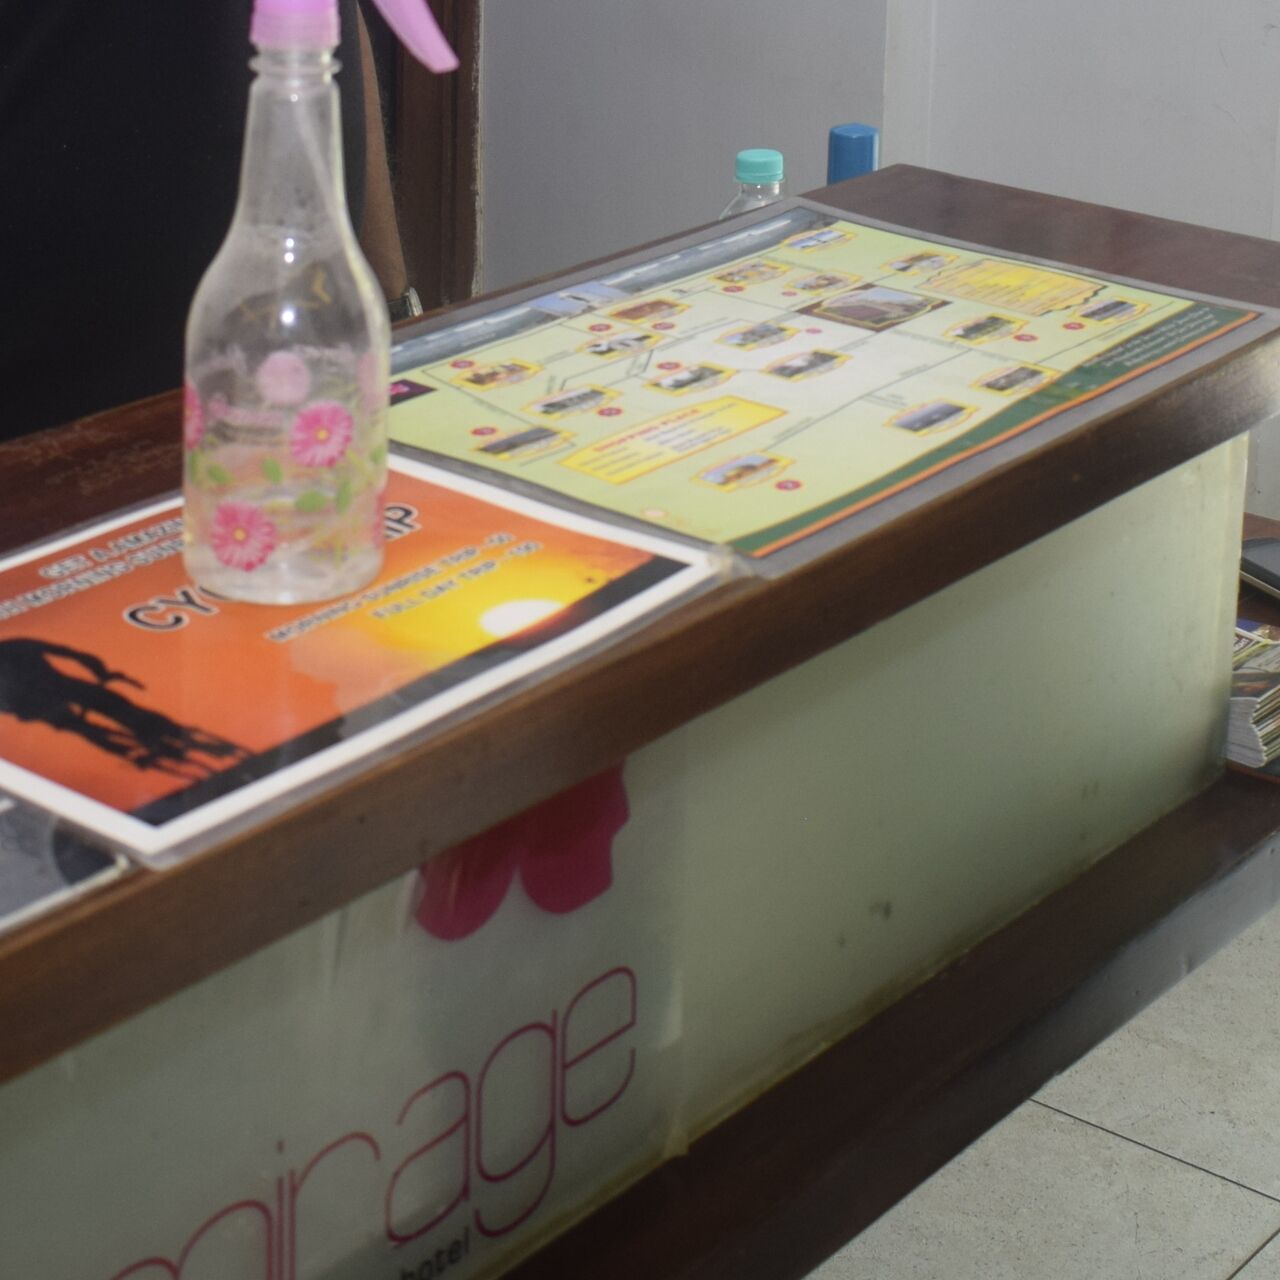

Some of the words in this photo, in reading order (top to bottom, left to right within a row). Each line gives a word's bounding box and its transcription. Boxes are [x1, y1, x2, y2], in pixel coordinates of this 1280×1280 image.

[124, 584, 230, 633] CY
[264, 596, 363, 643] MORNING
[439, 546, 480, 568] TRIP
[368, 596, 423, 622] FULL
[458, 559, 500, 581] TRIP
